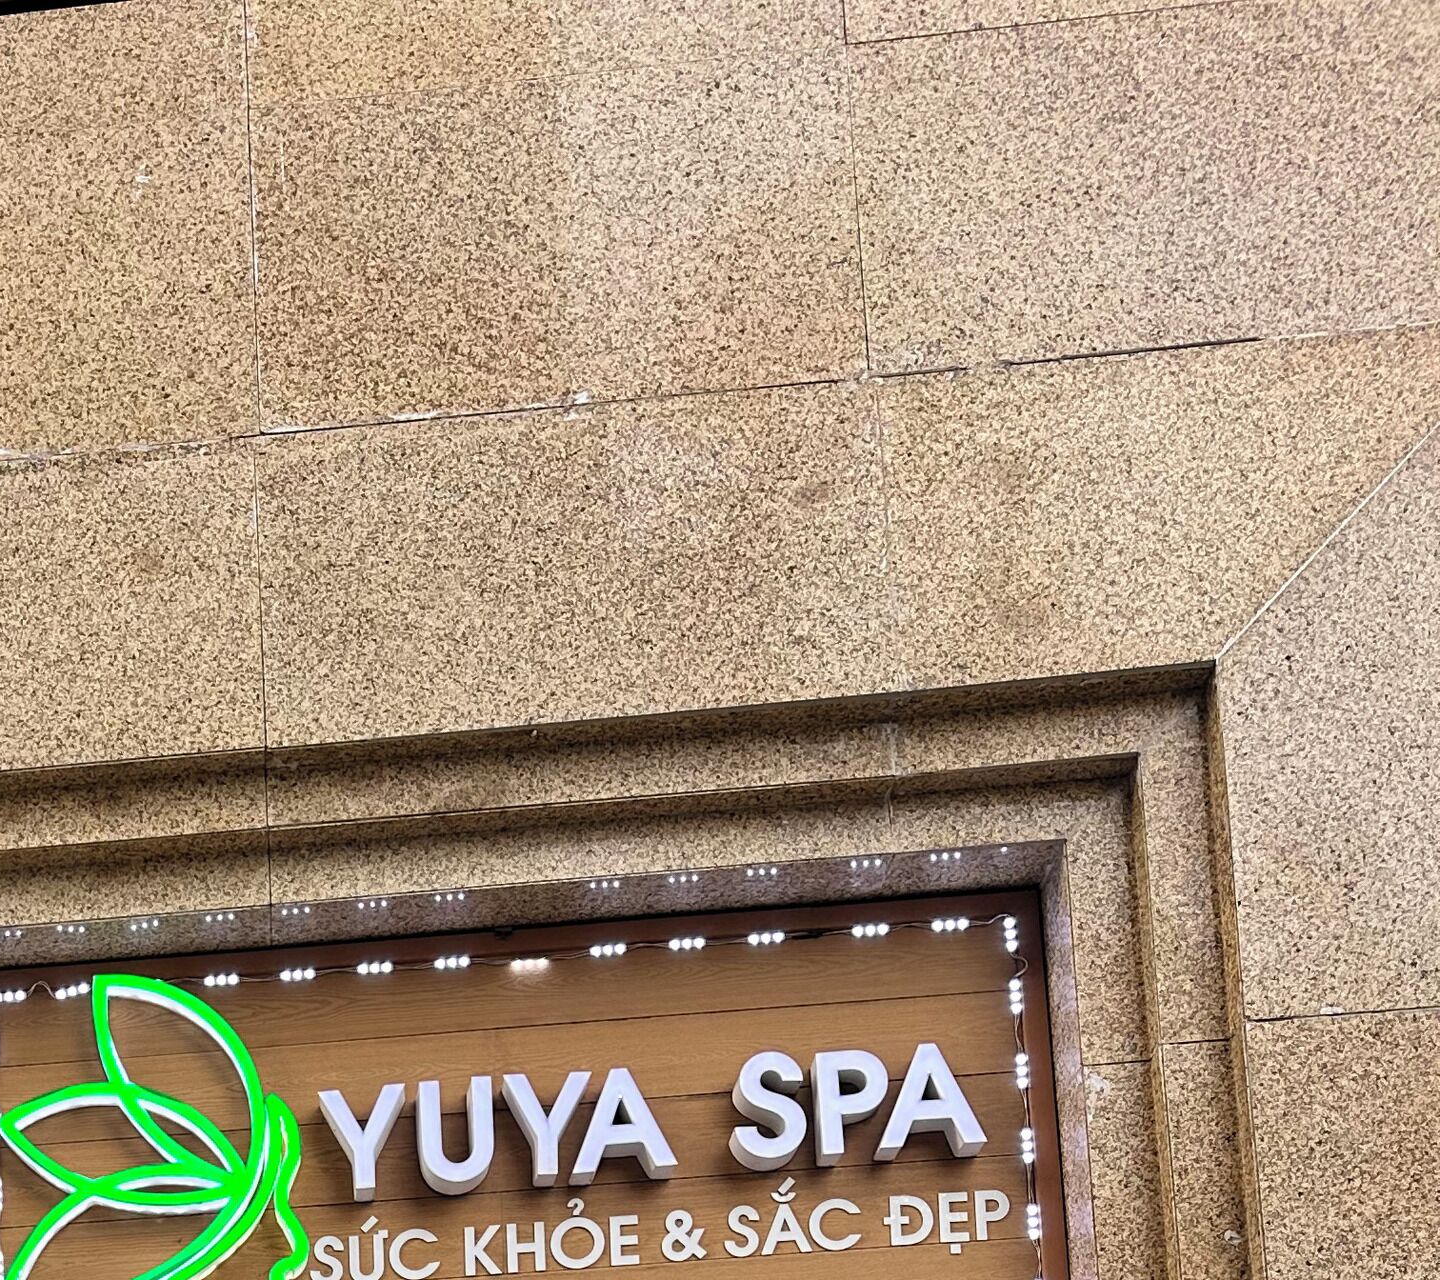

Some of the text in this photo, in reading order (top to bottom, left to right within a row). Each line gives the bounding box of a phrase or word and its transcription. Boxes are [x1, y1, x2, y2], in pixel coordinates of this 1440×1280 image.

[317, 1043, 988, 1200] YUYA SPA
[464, 1199, 640, 1276] KHỎE
[661, 1211, 708, 1262] &
[724, 1177, 861, 1257] SẮC
[884, 1189, 1010, 1255] ĐẸP
